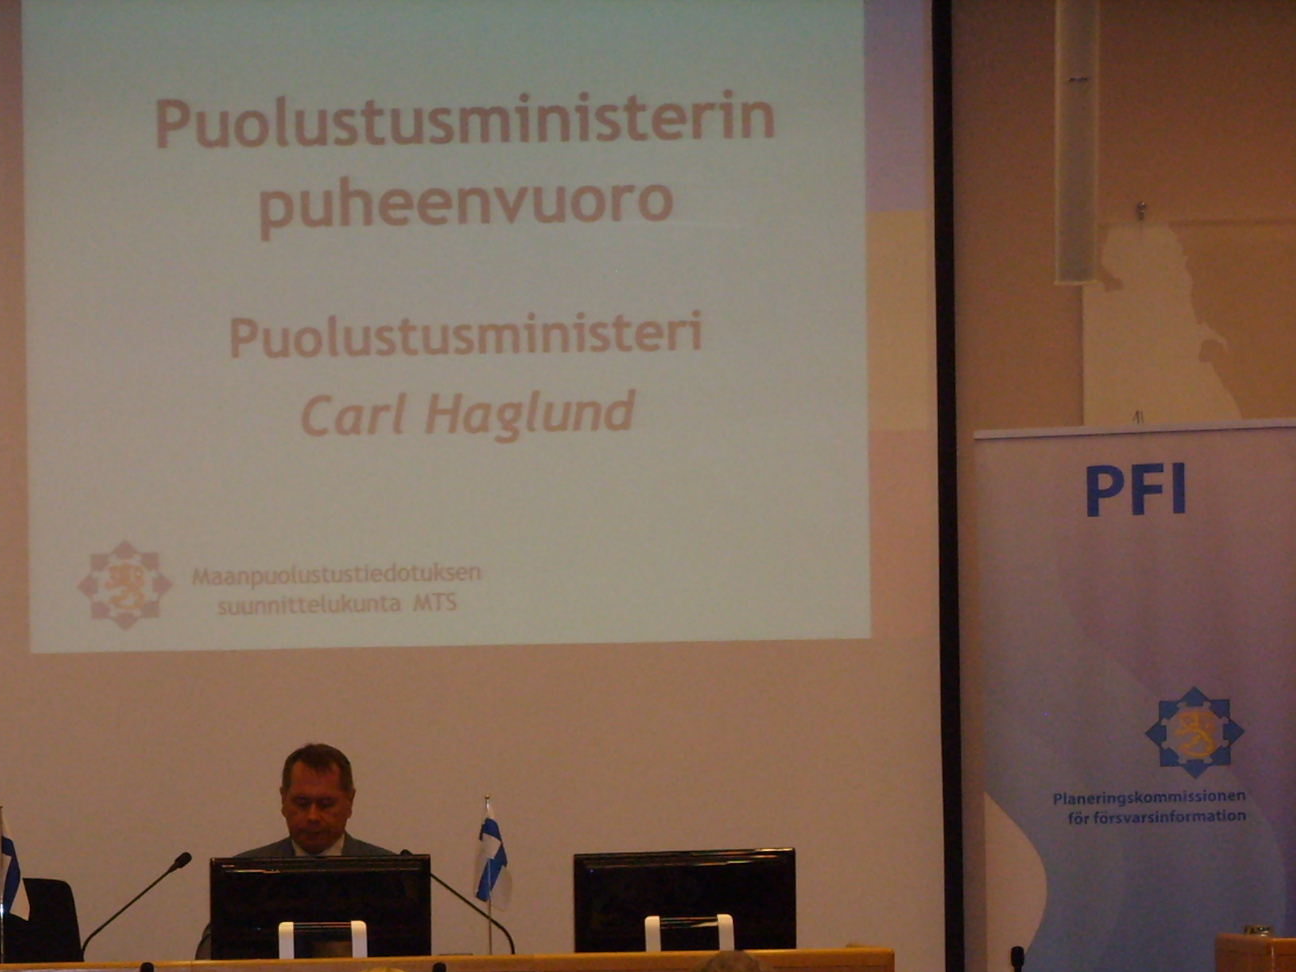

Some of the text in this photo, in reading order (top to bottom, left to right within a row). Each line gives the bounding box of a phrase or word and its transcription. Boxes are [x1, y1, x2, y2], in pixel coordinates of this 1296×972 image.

[156, 90, 776, 149] Puolustusministerin
[259, 177, 674, 241] puheenvuoro
[230, 310, 703, 359] Puolustusministeri
[301, 390, 636, 445] Carl Haglund
[1086, 462, 1186, 517] PFI
[192, 562, 482, 590] Maanpuolustustiedotuksen
[218, 592, 458, 616] suunnittelukunta MTS
[1053, 790, 1246, 807] Planeringskommissionen
[1068, 809, 1247, 825] för försvarsinformation
